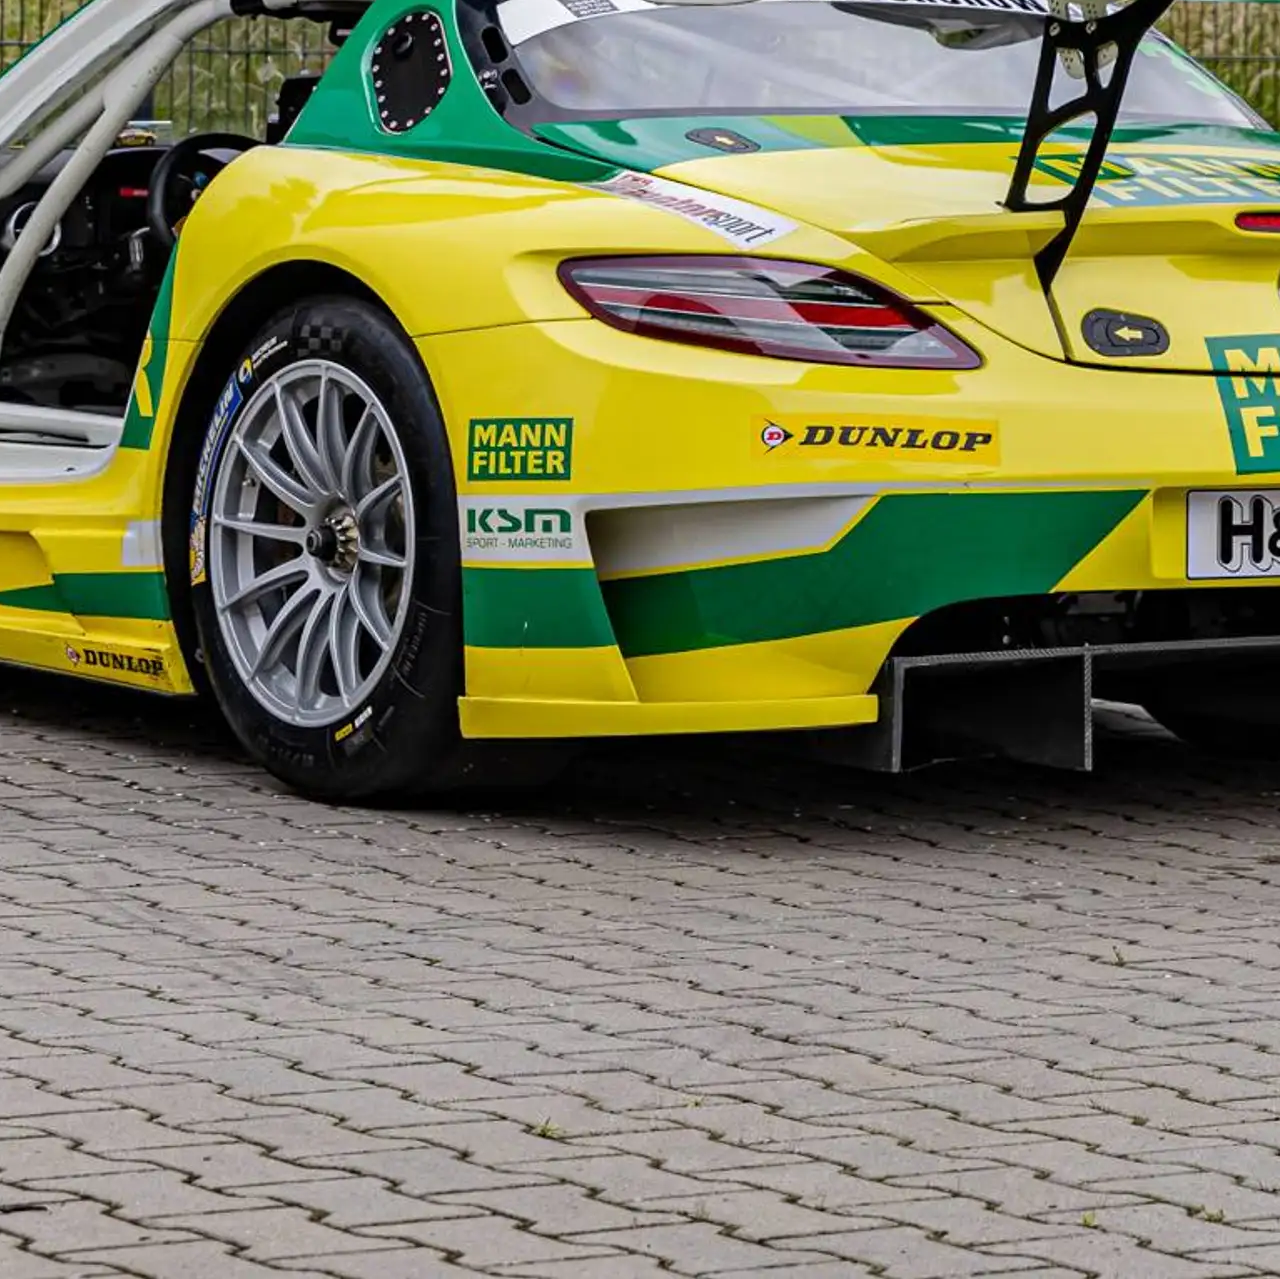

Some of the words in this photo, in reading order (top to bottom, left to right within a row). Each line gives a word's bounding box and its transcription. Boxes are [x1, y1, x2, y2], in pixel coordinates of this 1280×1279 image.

[473, 423, 567, 448] MANN
[798, 425, 993, 452] DUNLOP
[472, 451, 565, 474] FILTER
[466, 537, 499, 548] SPORT
[508, 537, 572, 549] MARKETING
[82, 648, 165, 677] DUNLOP
